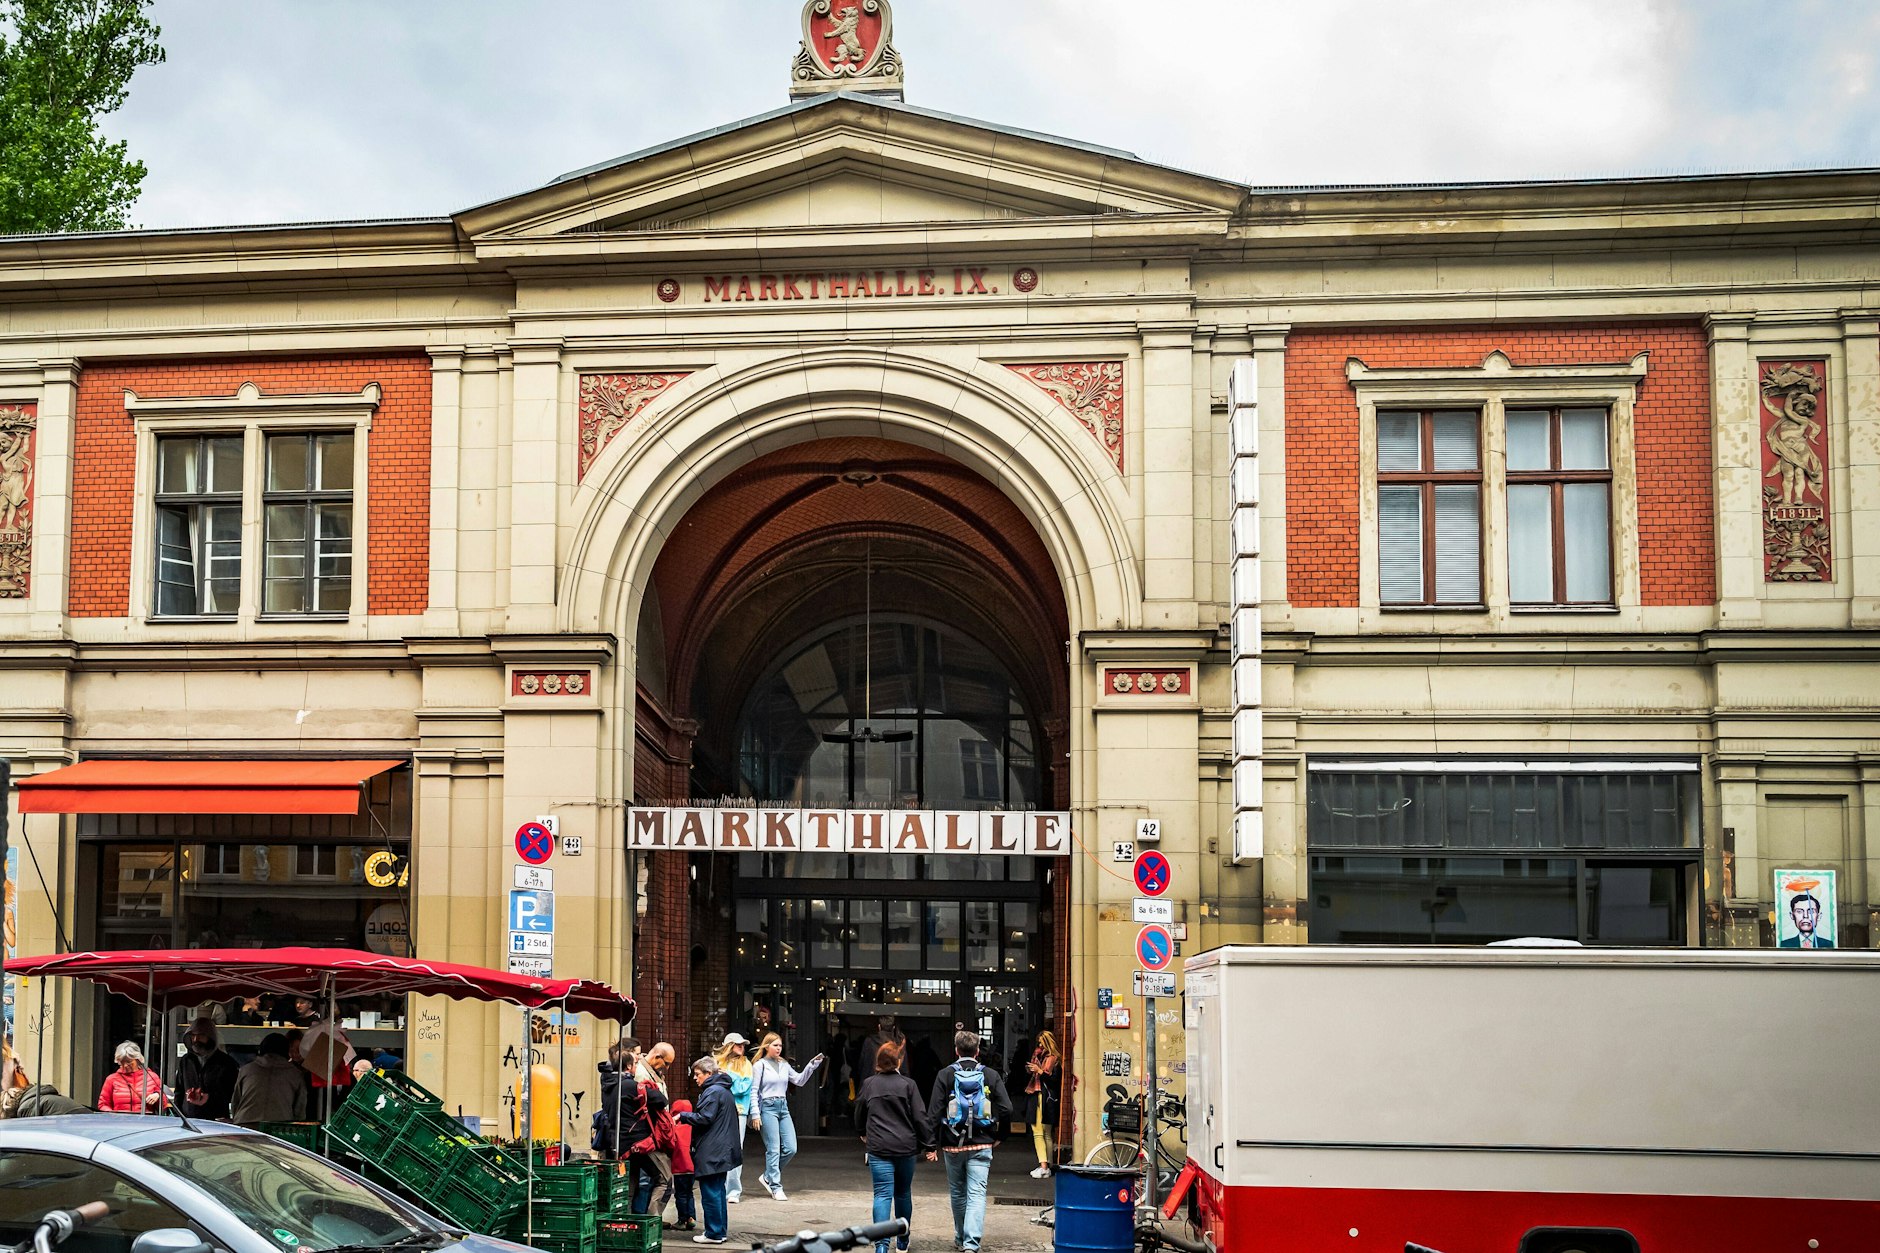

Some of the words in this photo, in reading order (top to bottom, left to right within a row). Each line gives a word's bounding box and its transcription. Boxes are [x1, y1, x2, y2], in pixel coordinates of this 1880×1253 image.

[632, 810, 1063, 851] MARKTHALLE
[1142, 823, 1157, 836] 42
[564, 838, 579, 849] 43
[1115, 844, 1133, 855] 42
[529, 869, 539, 878] Sa
[524, 878, 539, 887] 6-17
[516, 895, 538, 929] P
[1138, 906, 1147, 914] Sa
[527, 938, 532, 946] 2
[533, 939, 549, 948] Std.
[517, 960, 543, 968] Mo-Fr
[1142, 975, 1167, 984] Mo-Fr
